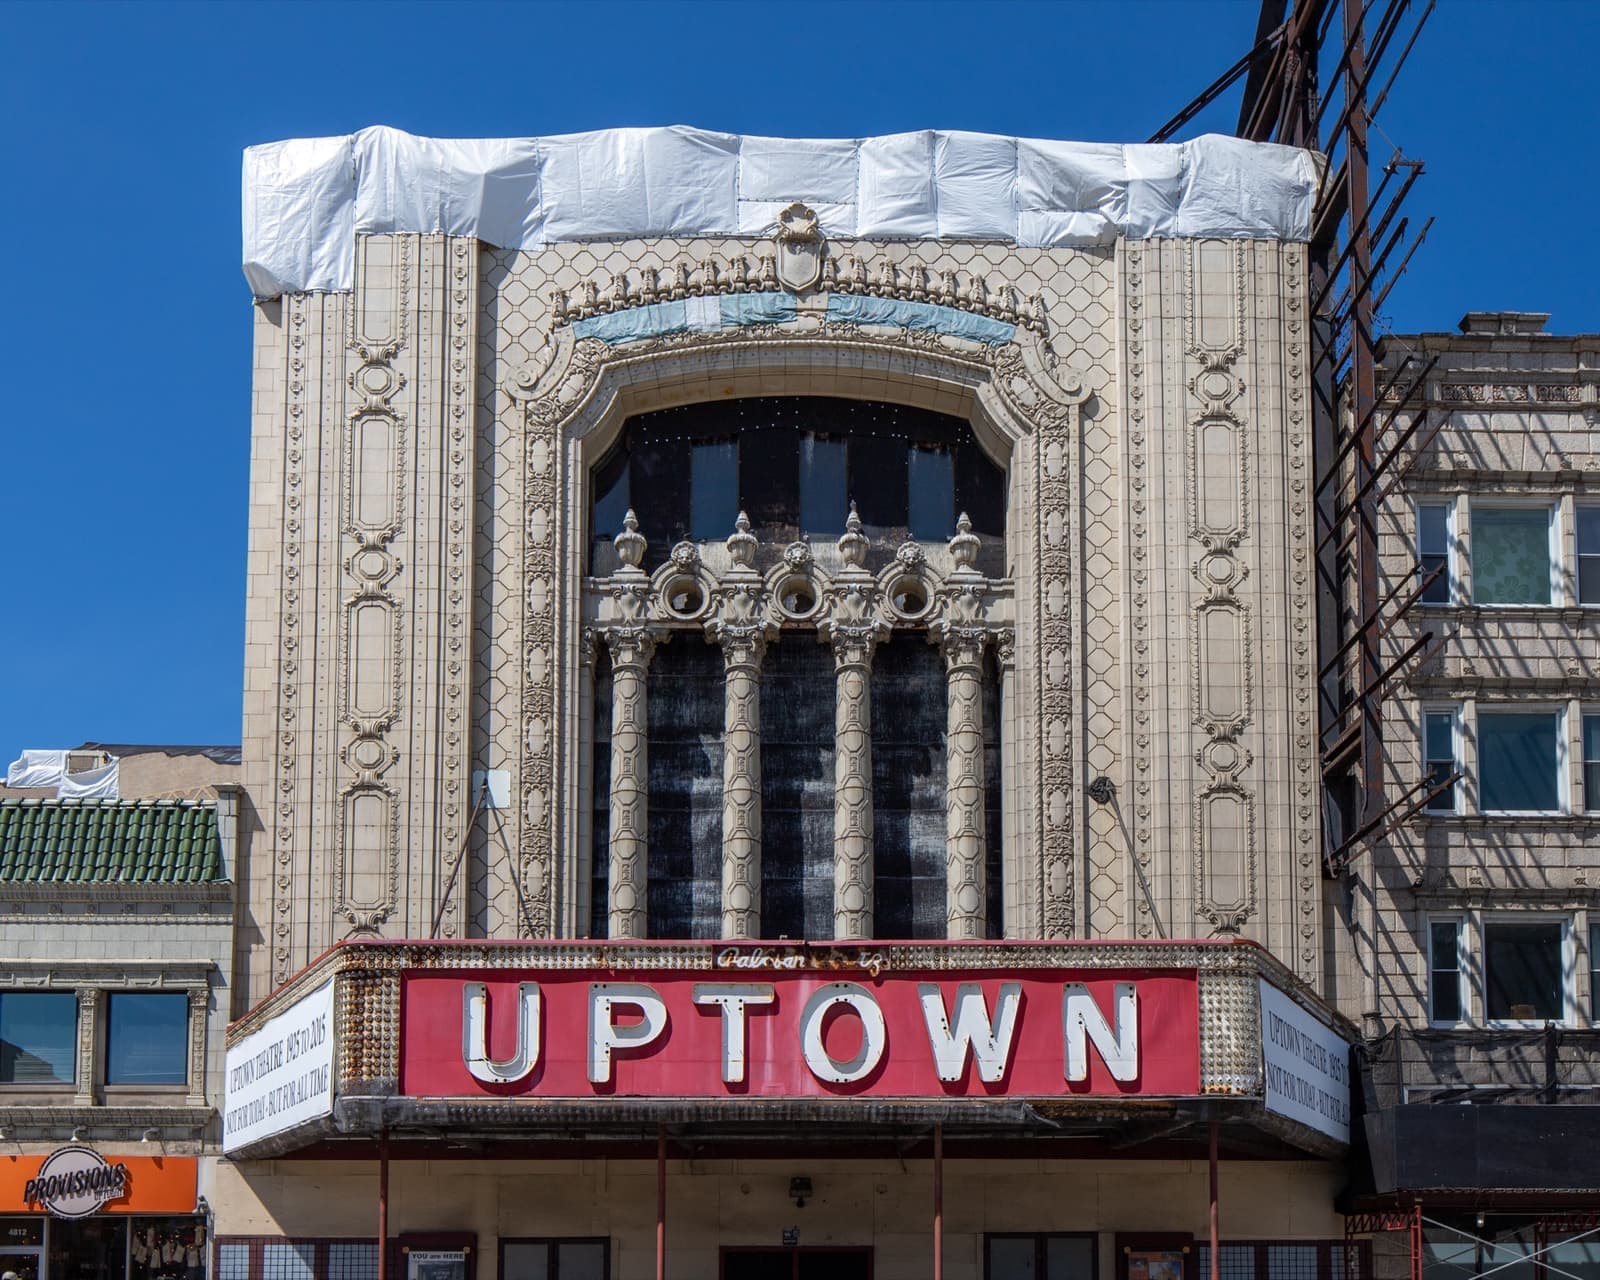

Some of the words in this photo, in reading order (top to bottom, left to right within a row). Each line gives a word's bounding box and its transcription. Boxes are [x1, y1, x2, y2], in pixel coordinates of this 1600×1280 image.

[461, 981, 1139, 1084] UPTOWN
[1268, 1010, 1301, 1057] UPTOWN
[1300, 1033, 1328, 1074] THEATRE
[230, 1057, 255, 1094] UPTOWN
[255, 1040, 283, 1080] THEATRE
[1267, 1061, 1282, 1095] NOT
[1283, 1069, 1297, 1101] FOR
[1296, 1078, 1316, 1111] TODAY
[226, 1109, 238, 1135] NOT
[237, 1103, 249, 1130] FOR
[249, 1095, 266, 1125] TODAY
[268, 1086, 282, 1117] BUT
[283, 1081, 296, 1111] FOR
[296, 1074, 309, 1104] ALL
[309, 1063, 329, 1097] TIME
[24, 1163, 126, 1204] PROVISIONS
[8, 1228, 28, 1236] 4812
